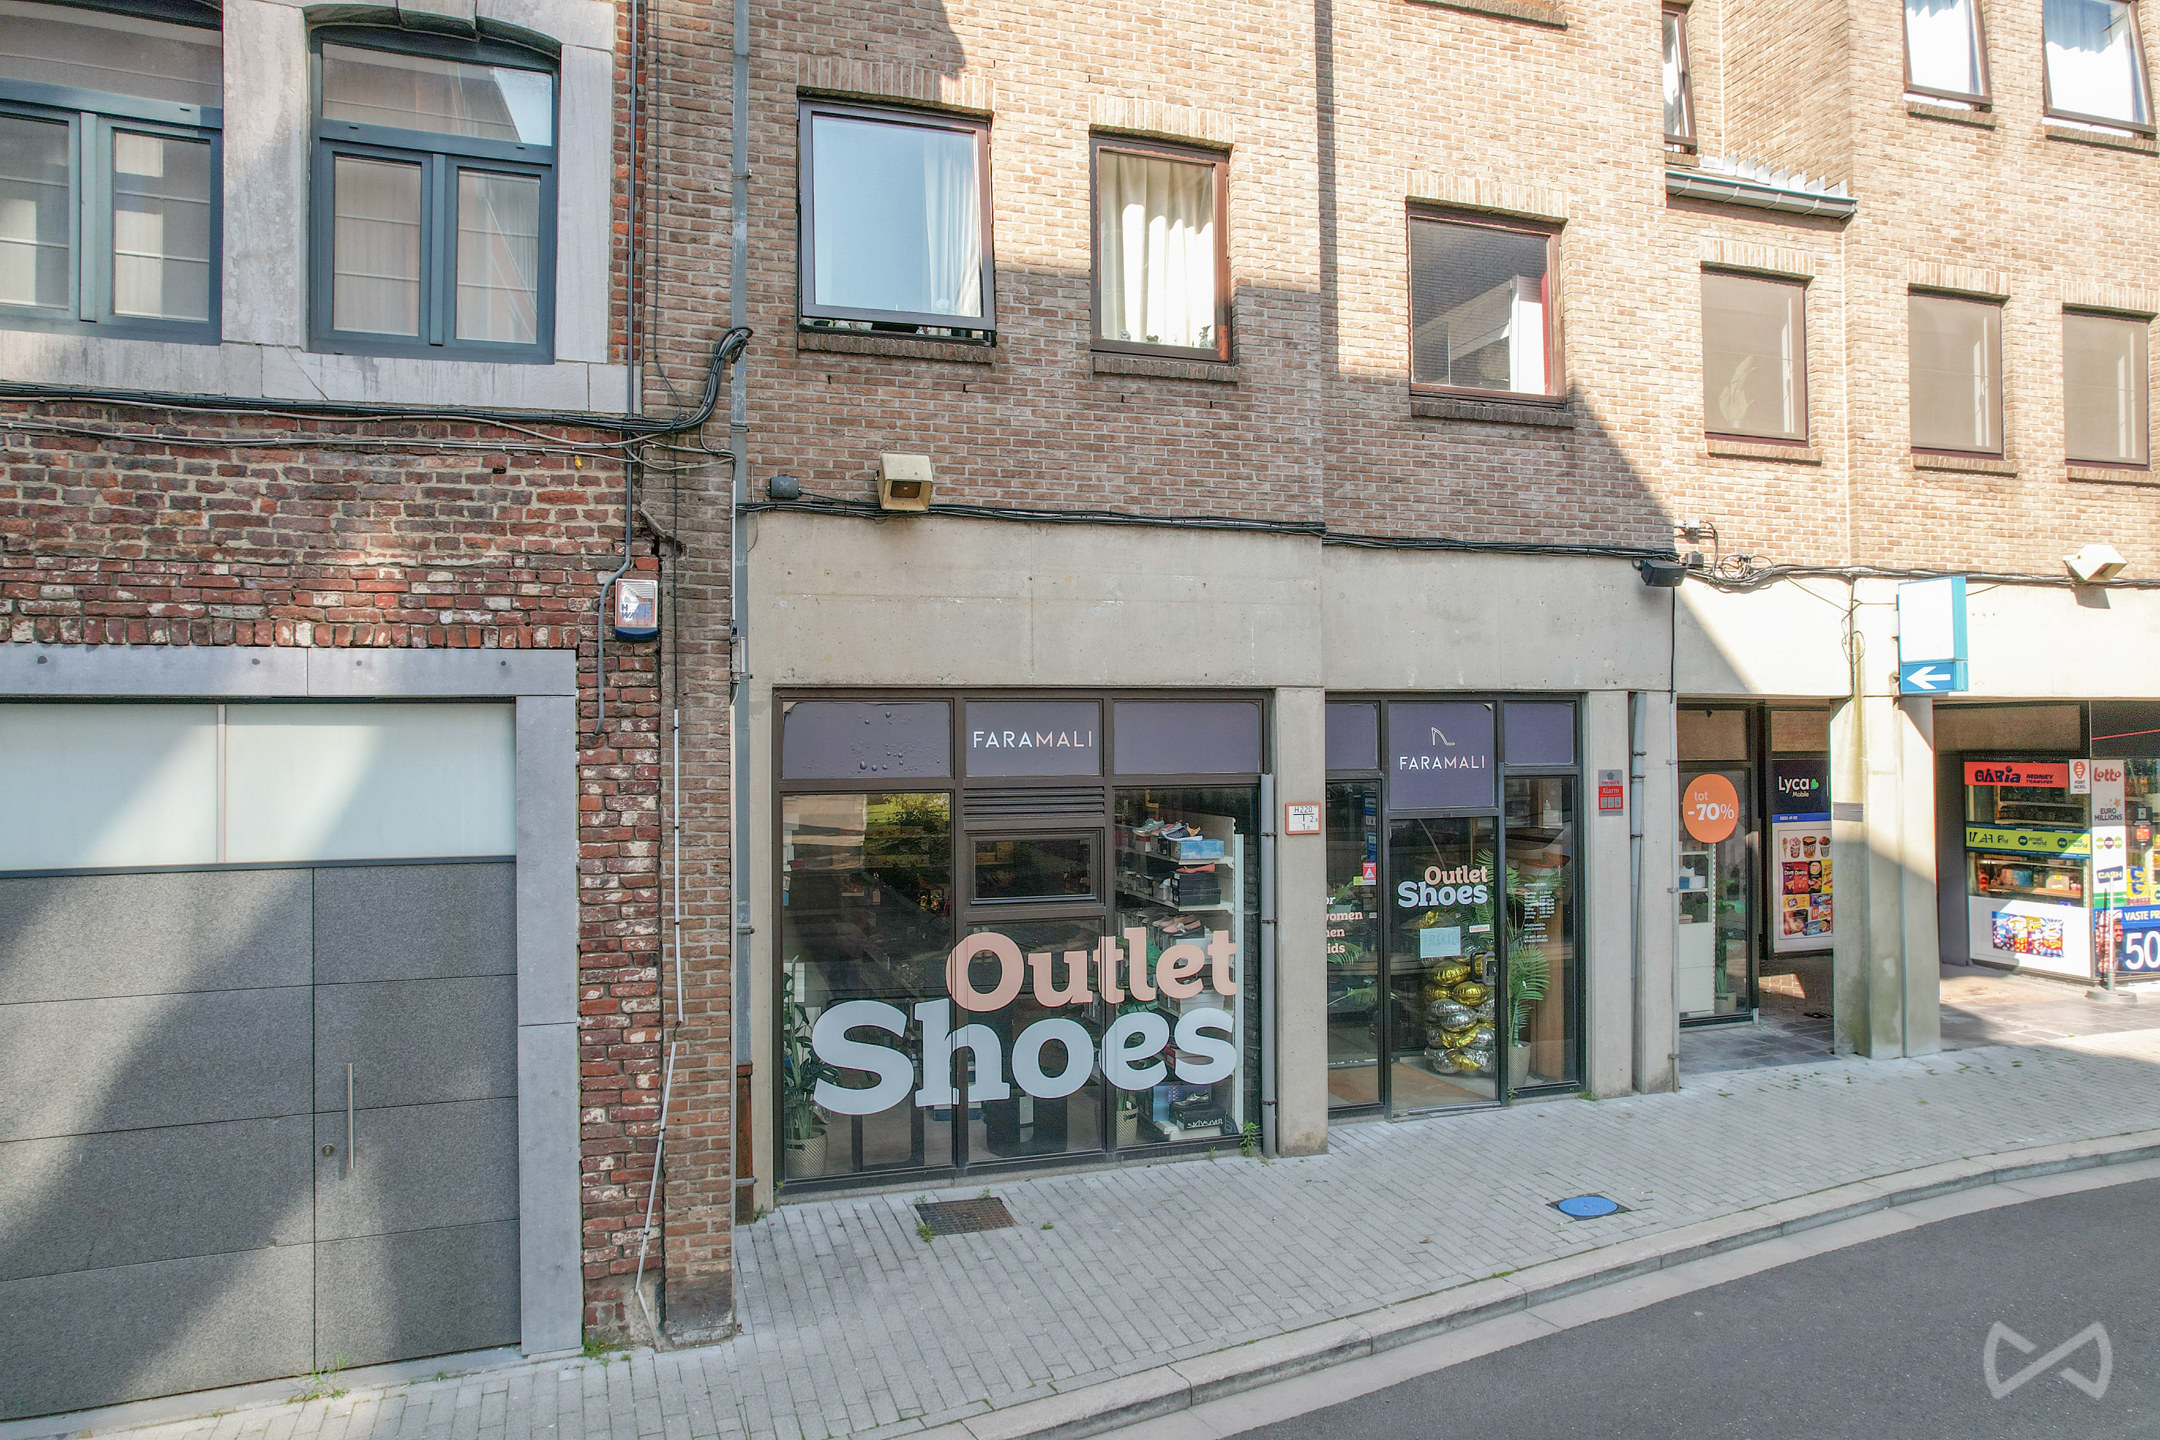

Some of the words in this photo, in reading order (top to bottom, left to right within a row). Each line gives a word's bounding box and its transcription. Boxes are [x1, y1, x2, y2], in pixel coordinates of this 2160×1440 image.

[973, 730, 1092, 748] FARAMALI
[1399, 755, 1485, 770] FARAMALI
[2093, 767, 2121, 782] Lotto
[1778, 776, 1810, 793] Lyca
[1694, 791, 1708, 801] tot
[1688, 803, 1734, 820] -70%
[1424, 865, 1488, 885] Outlet
[2098, 872, 2122, 880] CASH
[1397, 881, 1488, 908] Shoes
[2124, 911, 2150, 921] VASTE
[2125, 930, 2160, 970] 50
[946, 927, 1237, 1012] Outlet
[811, 998, 1237, 1115] Shoes
